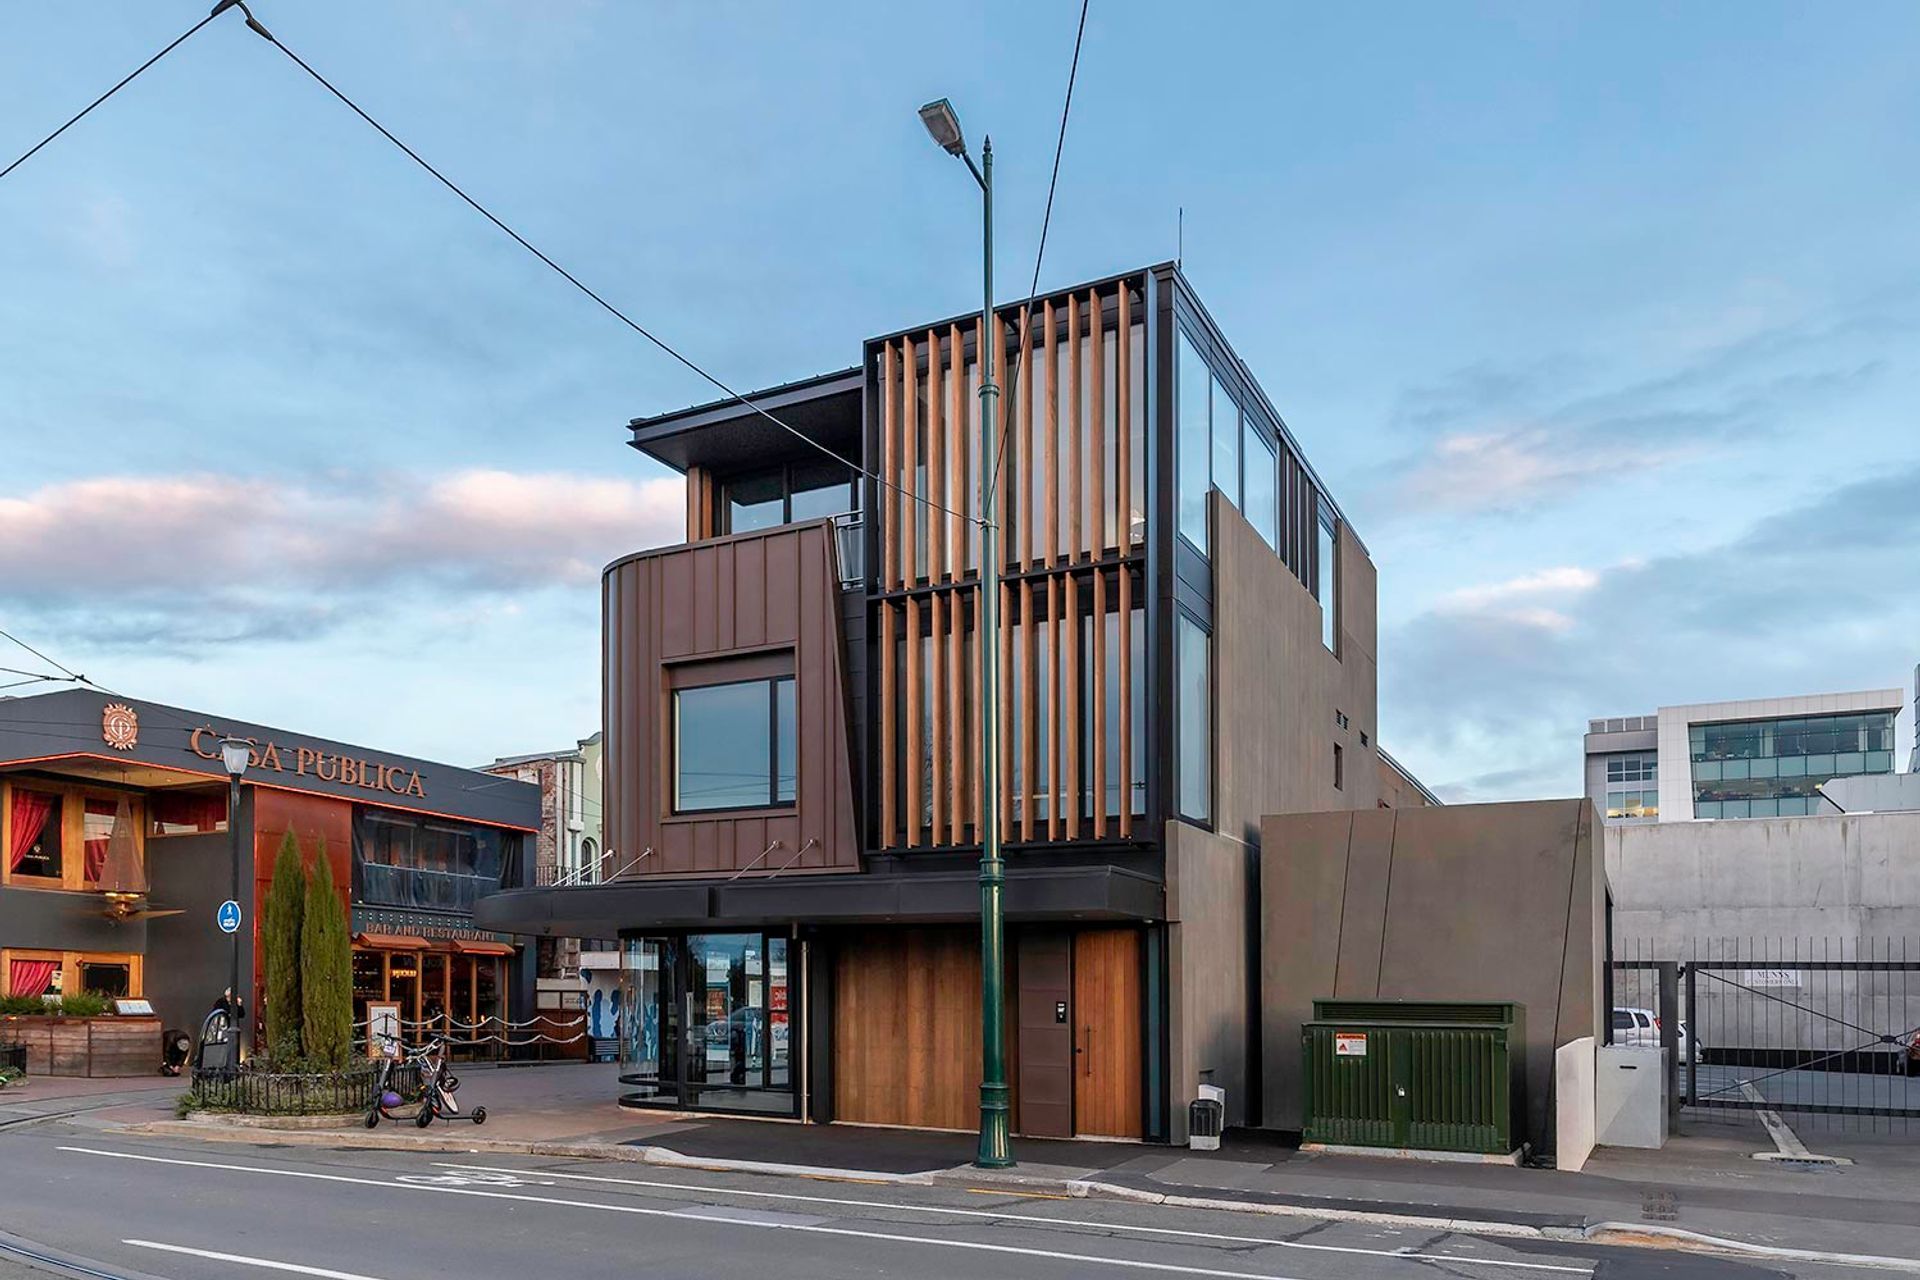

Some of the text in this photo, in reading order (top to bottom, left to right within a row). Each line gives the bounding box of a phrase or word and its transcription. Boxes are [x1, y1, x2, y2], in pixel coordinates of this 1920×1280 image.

[190, 727, 425, 798] CSA PUBLICA
[366, 923, 496, 941] BAR AND RESTAURANT
